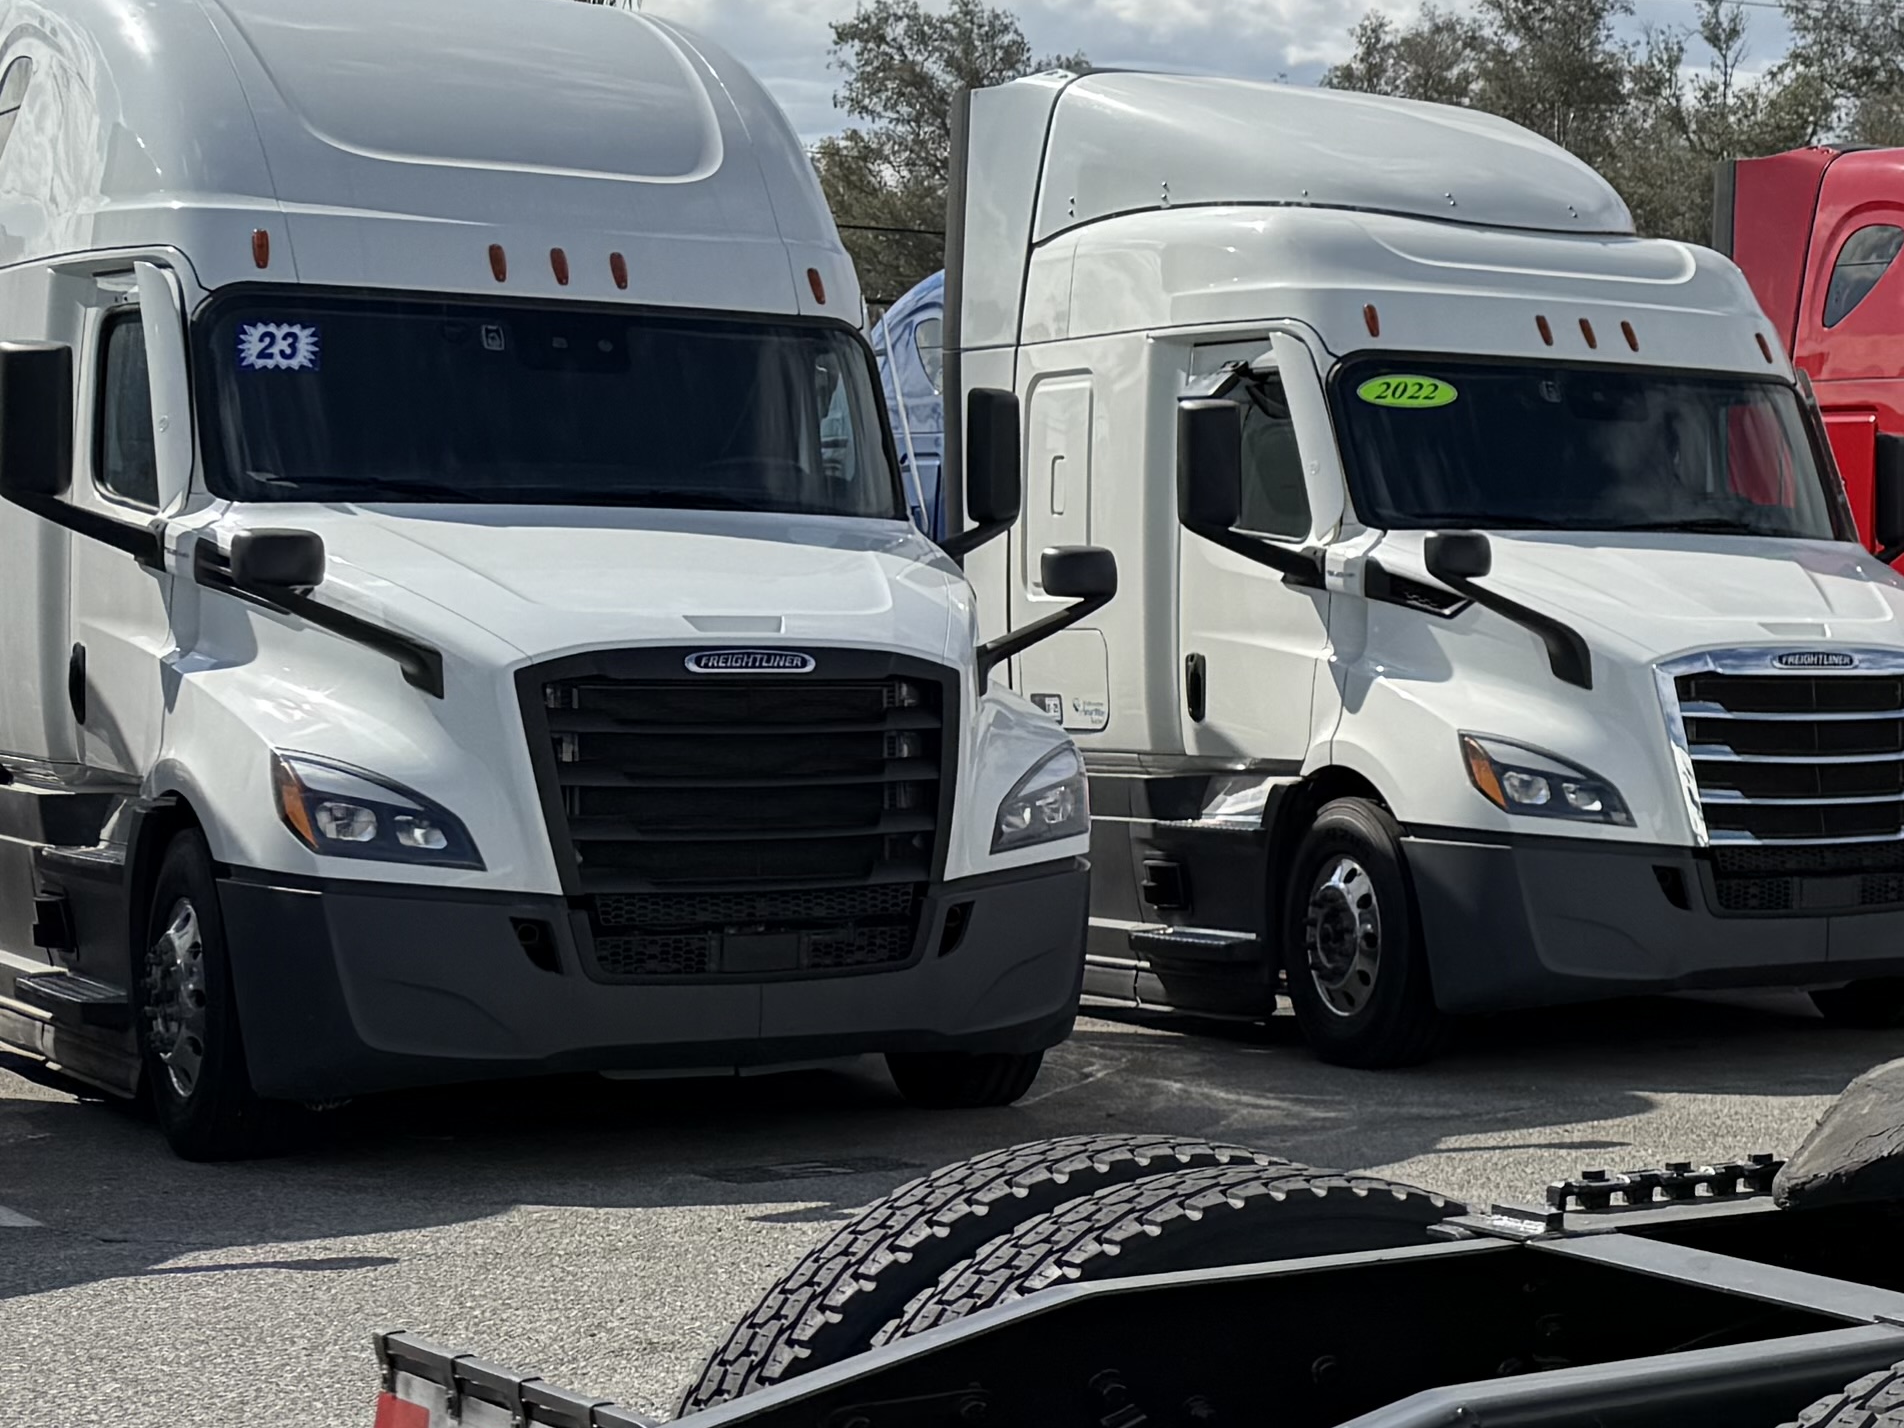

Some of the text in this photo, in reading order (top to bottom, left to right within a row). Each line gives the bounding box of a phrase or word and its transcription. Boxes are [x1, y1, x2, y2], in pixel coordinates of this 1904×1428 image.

[256, 330, 299, 360] 23
[1374, 379, 1439, 400] 2022
[700, 654, 802, 667] FREIGHTLINER
[1782, 654, 1851, 666] FREIGHTLINER
